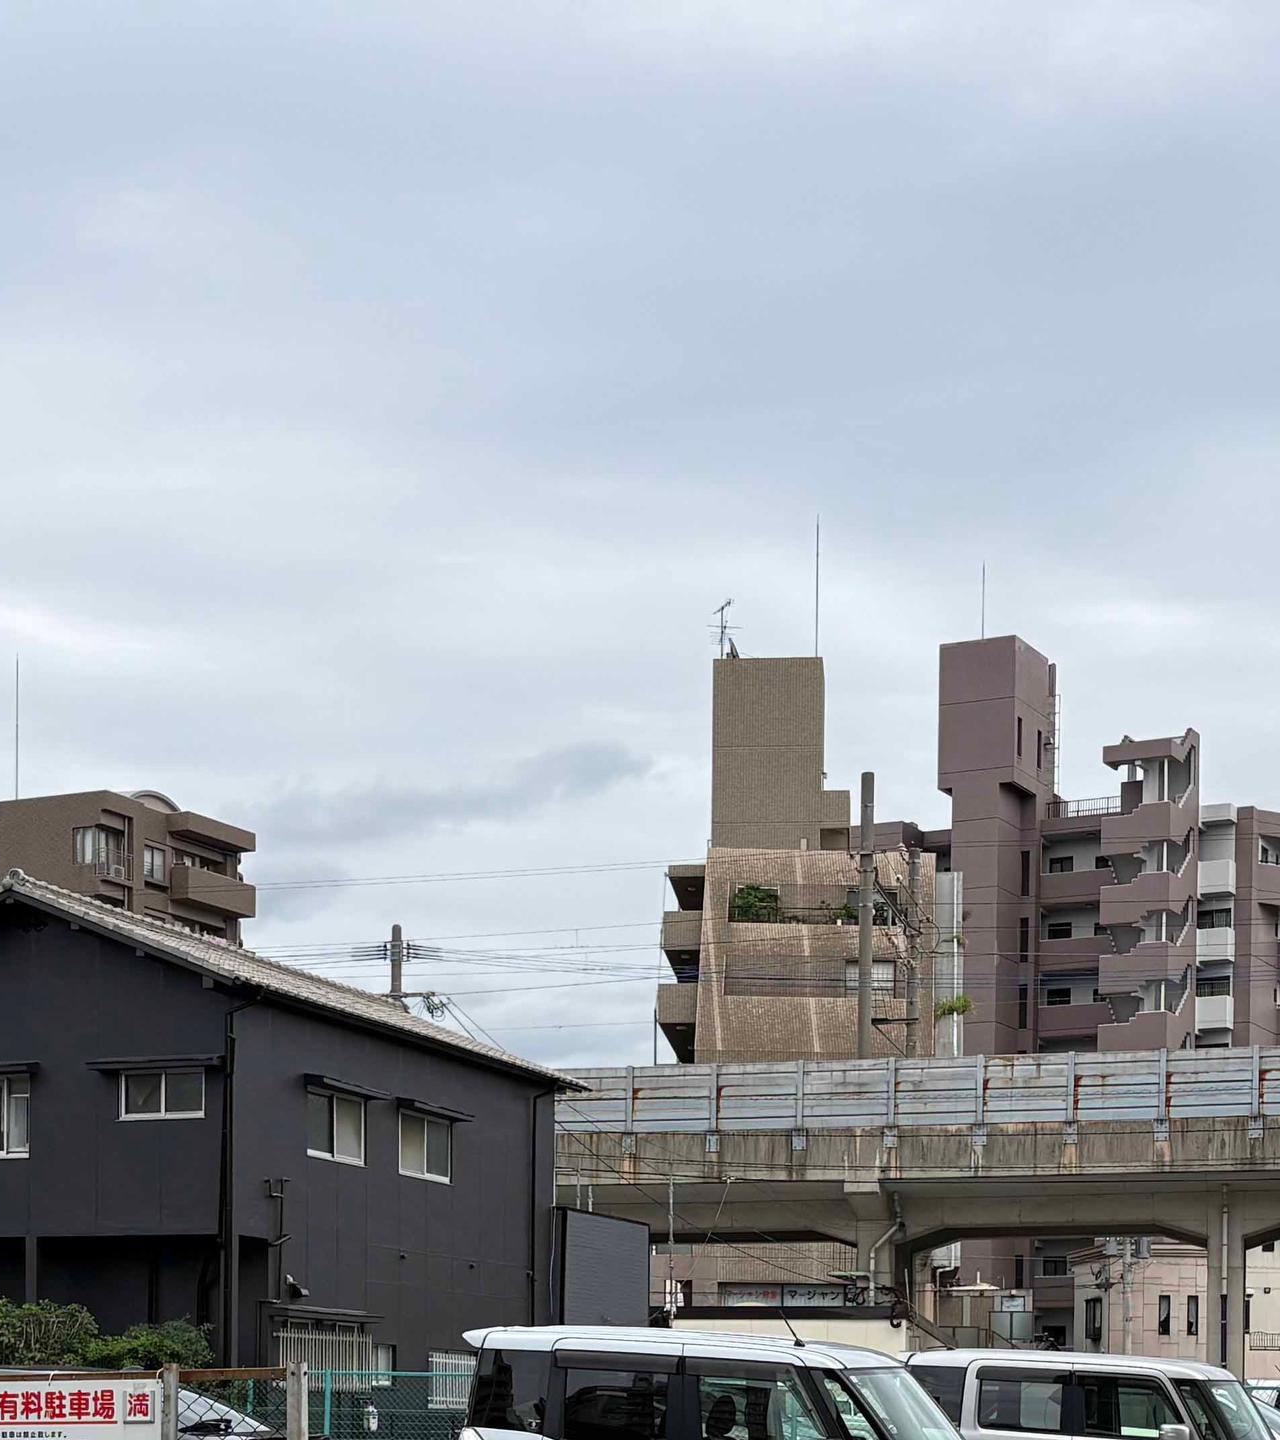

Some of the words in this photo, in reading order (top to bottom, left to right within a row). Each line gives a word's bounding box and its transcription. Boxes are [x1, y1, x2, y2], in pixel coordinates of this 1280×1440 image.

[787, 1289, 839, 1300] マージャン
[127, 1392, 150, 1418] 満
